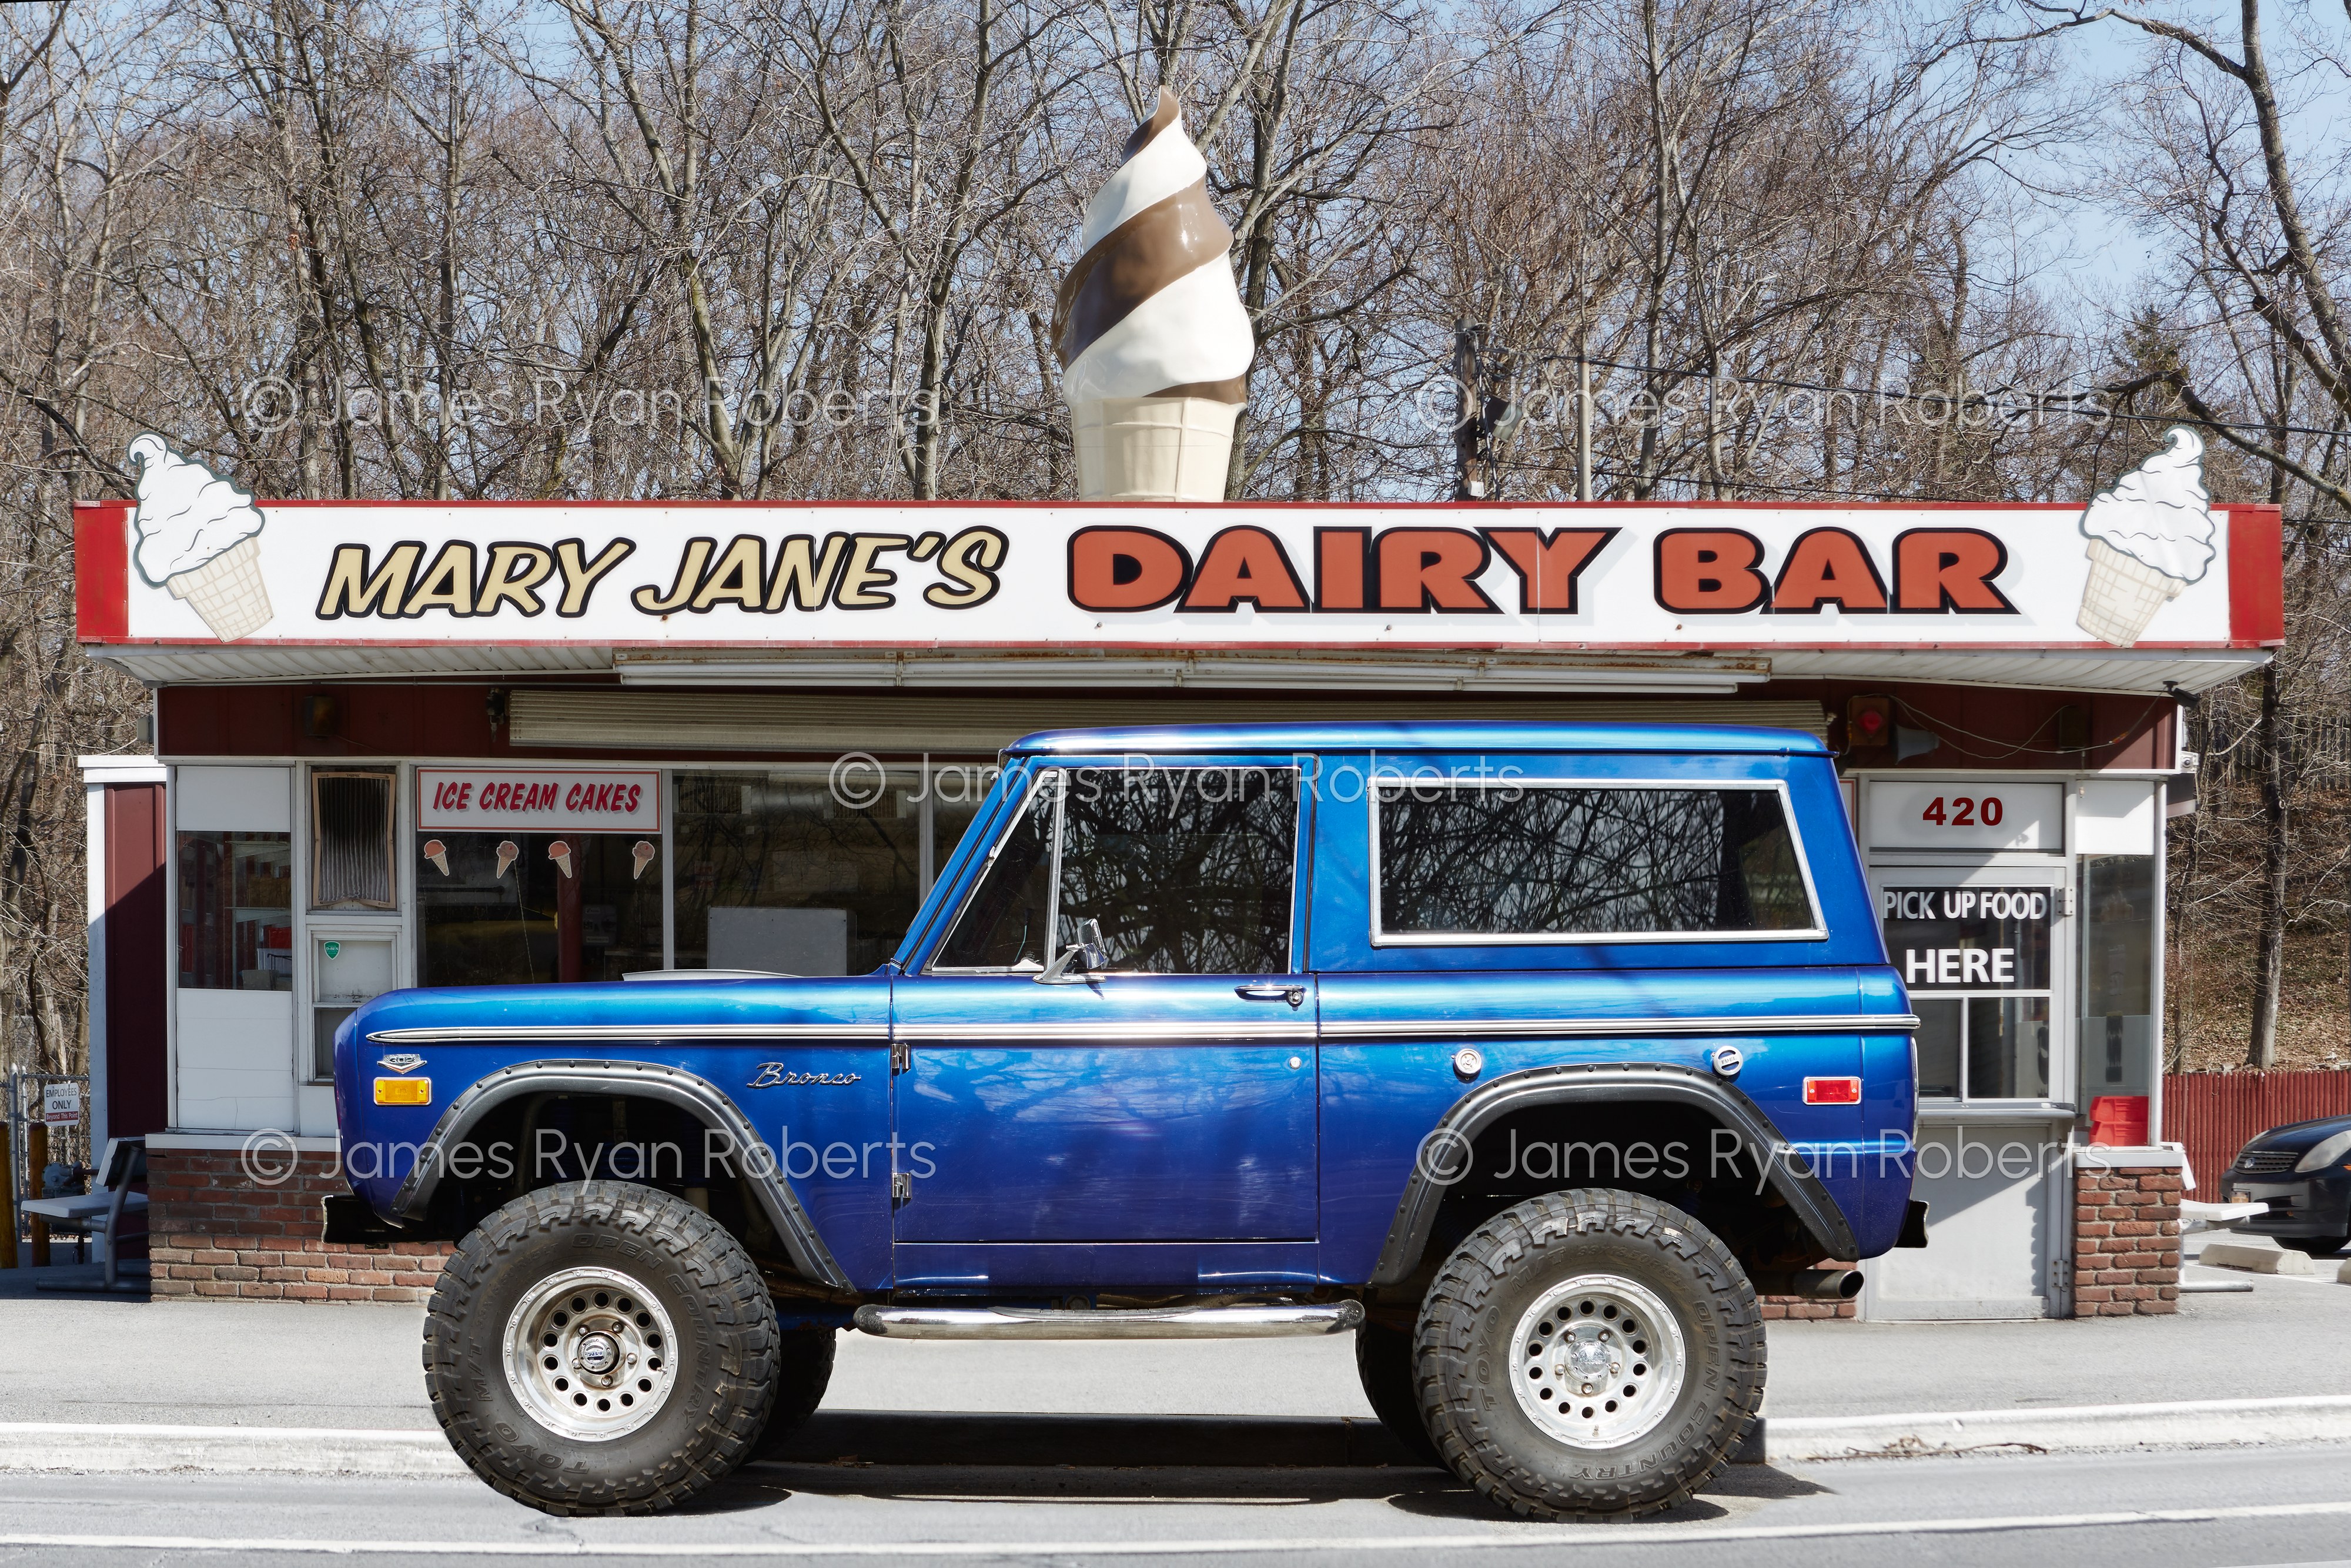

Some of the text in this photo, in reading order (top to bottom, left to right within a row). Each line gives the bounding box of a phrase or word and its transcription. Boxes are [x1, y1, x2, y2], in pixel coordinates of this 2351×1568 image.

[315, 525, 2021, 620] MARY JANE'S DAIRY BAR
[433, 782, 641, 813] ICE CREAM CAKES
[1922, 797, 2003, 826] 420
[1884, 891, 2047, 920] PICK UP FOOD
[1906, 948, 2015, 984] HERE
[46, 1088, 76, 1097] EMPLOYEES
[747, 1062, 861, 1088] Bronco
[52, 1099, 72, 1109] ONLY
[1510, 1246, 1566, 1293] M/T
[571, 1233, 663, 1269] OPEN
[665, 1273, 711, 1429] COUNTRY
[468, 1336, 493, 1401] M/T
[1476, 1305, 1500, 1410] TOYO
[1569, 1300, 1720, 1480] OPEN COUNTRY
[495, 1420, 590, 1475] TOYO
